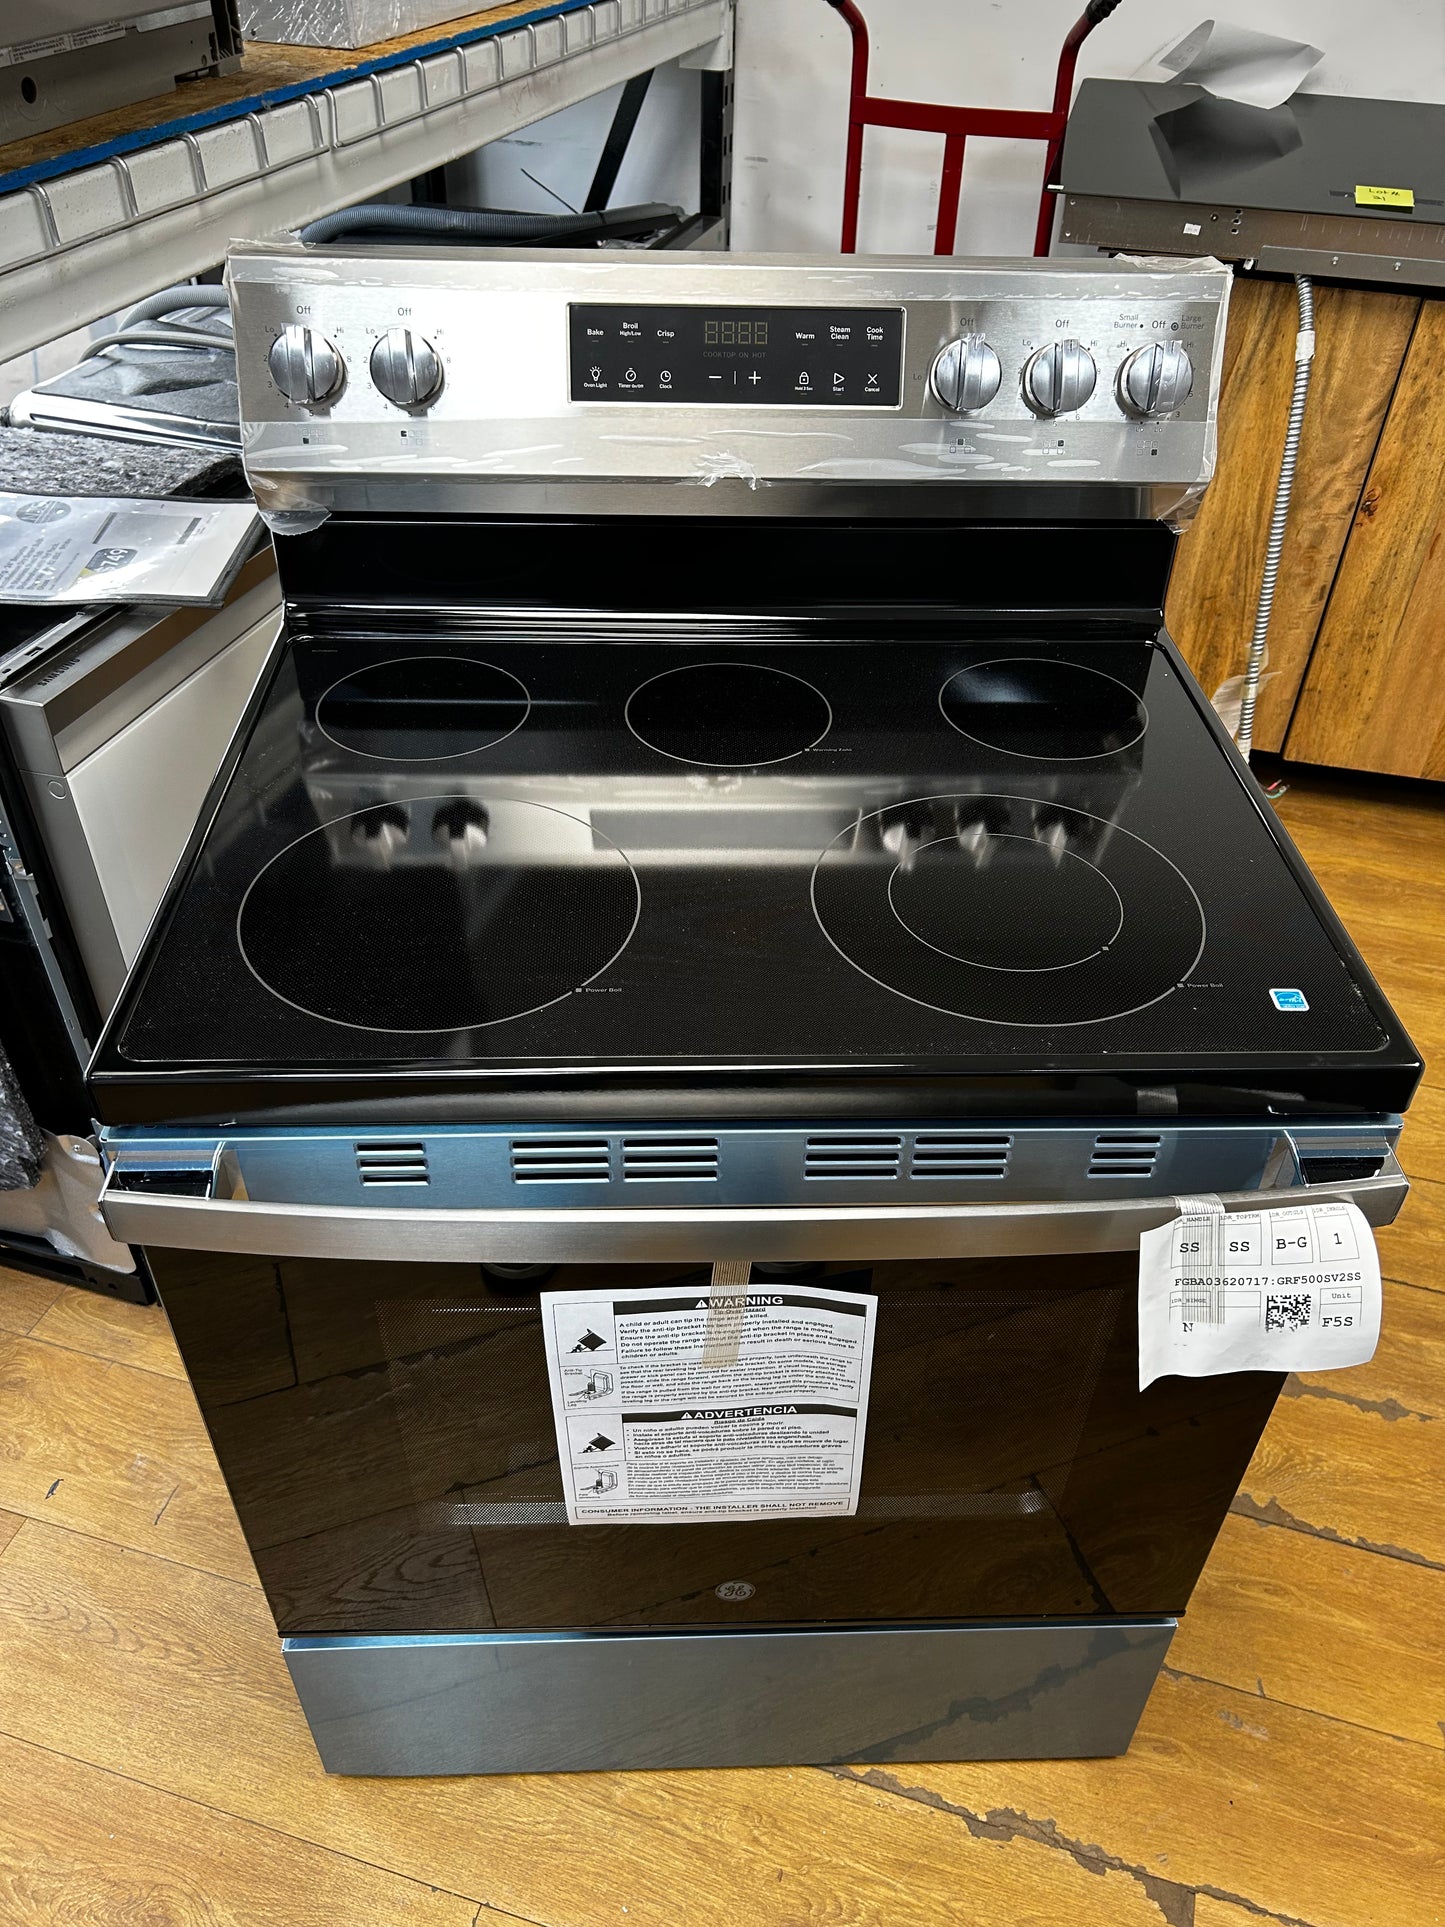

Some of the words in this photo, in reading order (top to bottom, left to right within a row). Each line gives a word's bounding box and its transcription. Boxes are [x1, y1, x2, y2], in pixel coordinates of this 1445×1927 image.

[296, 306, 311, 315] Off
[397, 308, 412, 316] Off
[960, 318, 975, 326] Off
[1055, 319, 1069, 328] Off
[1152, 320, 1166, 329] Off
[37, 658, 80, 686] SAMSUNG
[1276, 1237, 1307, 1249] B-G
[1334, 1233, 1342, 1244] 1
[1180, 1243, 1200, 1252] SS
[1229, 1242, 1250, 1252] SS
[1174, 1272, 1361, 1286] FGBA03620717:GRF500SV2SS
[709, 1296, 784, 1308] WARNING
[1182, 1322, 1194, 1332] N
[1322, 1317, 1353, 1327] F5S
[694, 1406, 798, 1419] ADVERTENCIA
